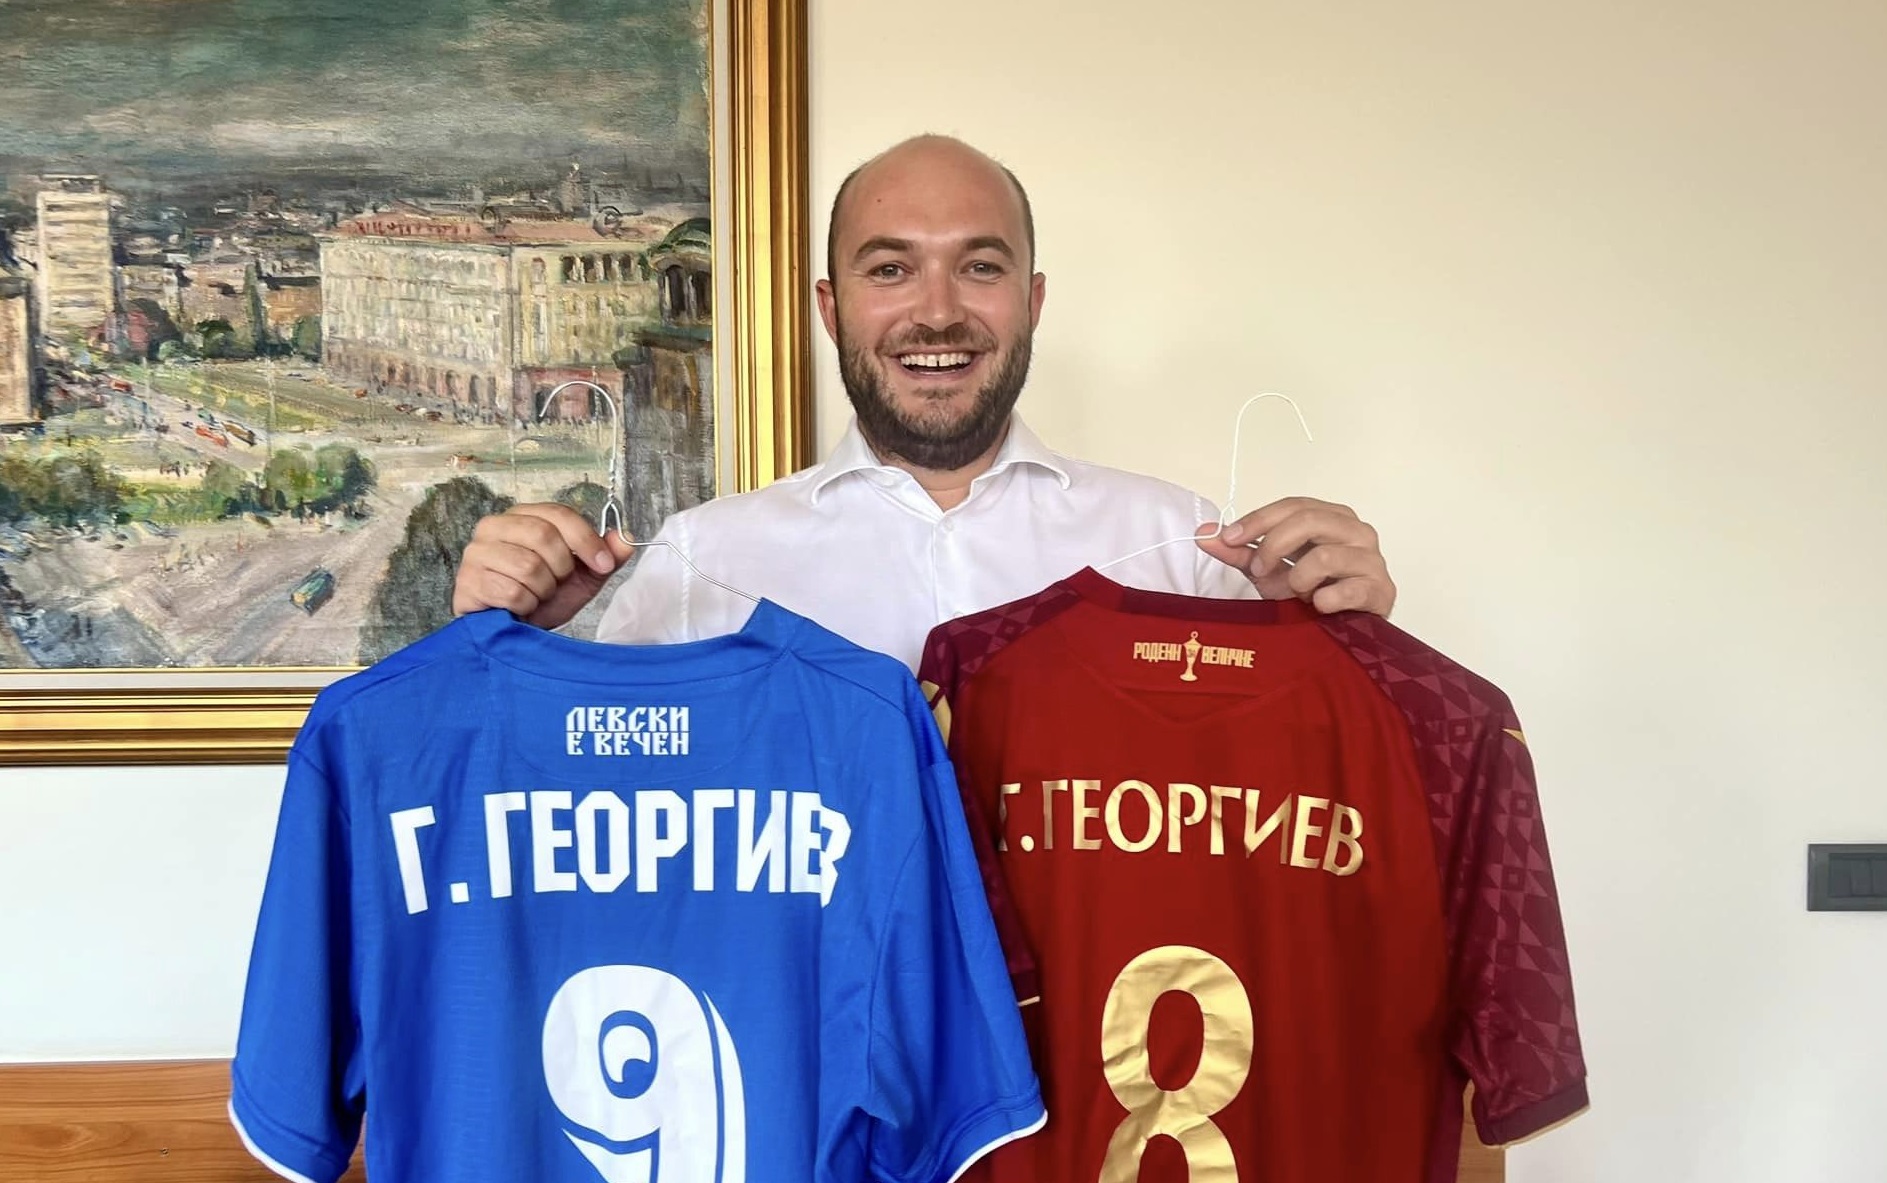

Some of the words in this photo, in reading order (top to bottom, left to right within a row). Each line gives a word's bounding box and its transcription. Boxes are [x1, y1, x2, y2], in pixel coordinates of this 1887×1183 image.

[566, 706, 689, 732] ЛЕВСКИ
[566, 732, 584, 755] Е
[594, 732, 689, 756] ВЕЧЕН
[542, 964, 746, 1183] 9
[1097, 944, 1254, 1183] 8
